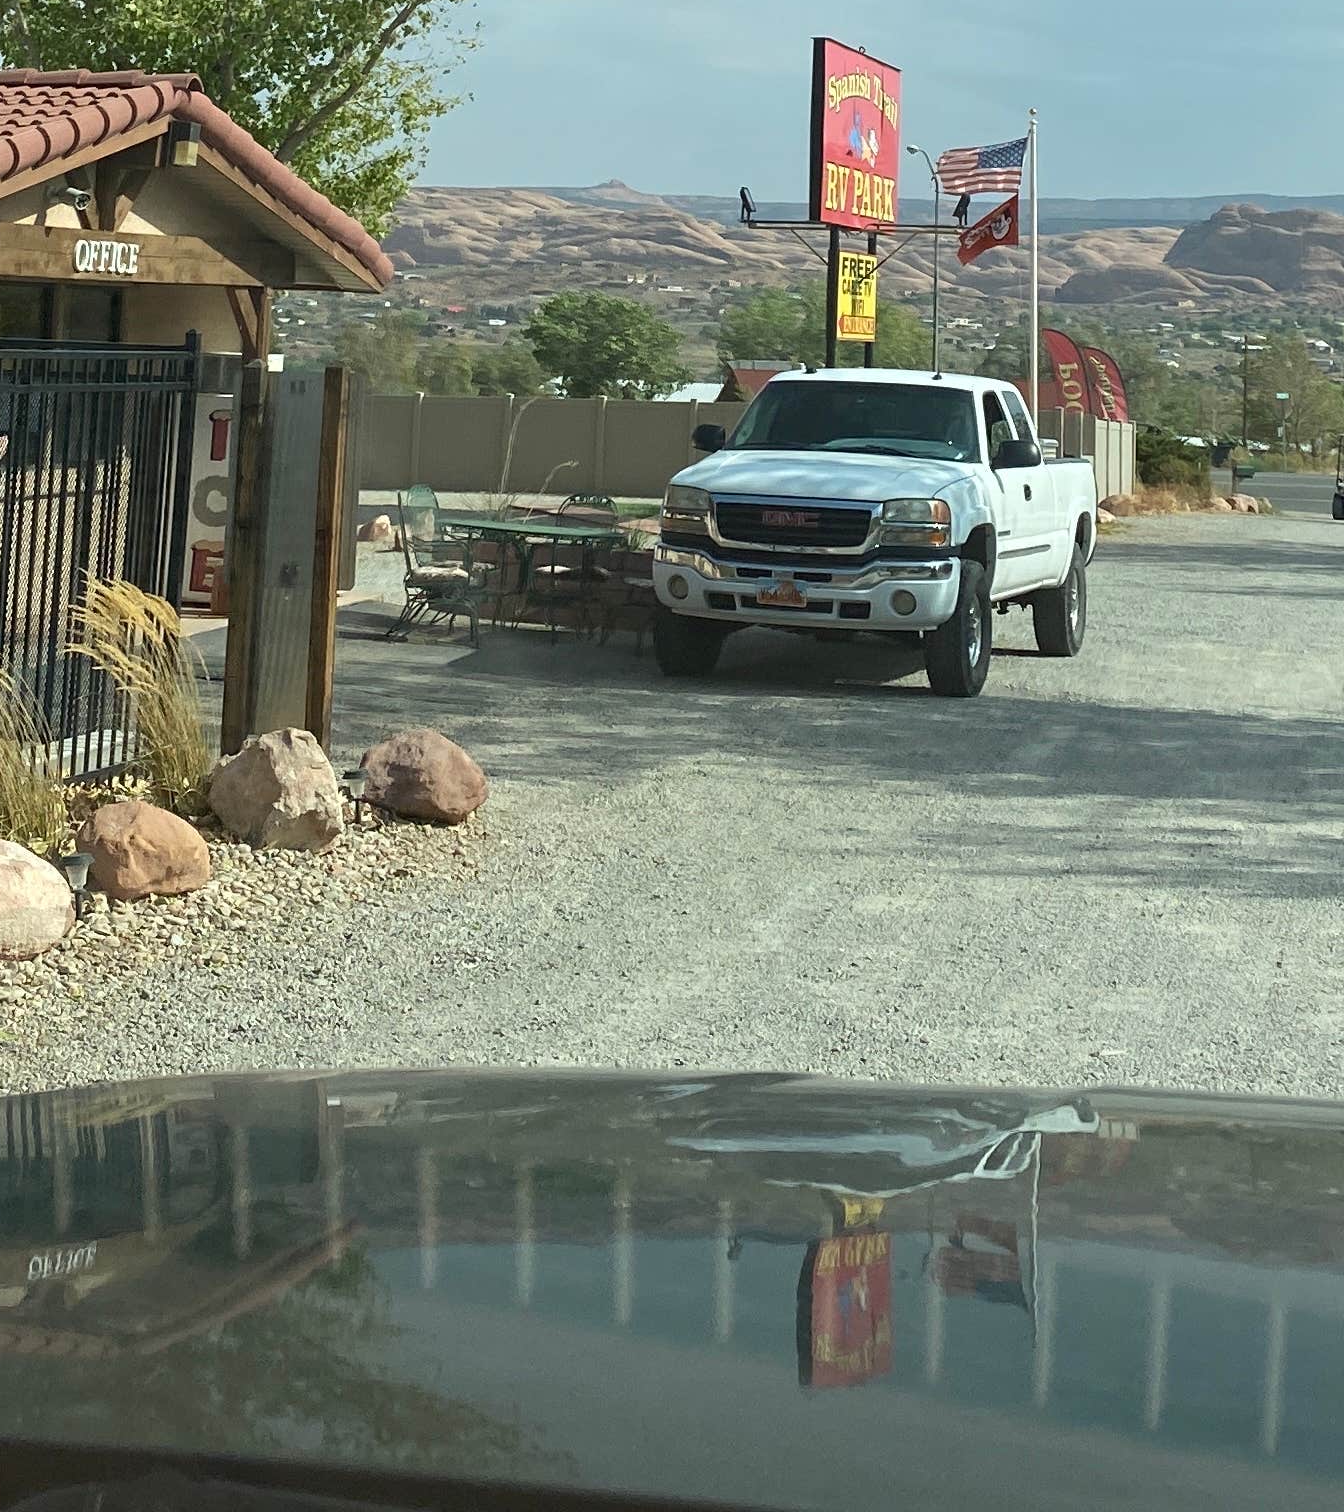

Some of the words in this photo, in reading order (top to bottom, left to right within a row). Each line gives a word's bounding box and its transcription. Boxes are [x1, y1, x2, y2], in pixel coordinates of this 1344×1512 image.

[828, 67, 871, 113] Spanish
[873, 74, 898, 130] Trail
[825, 162, 850, 212] RV
[851, 169, 895, 223] PARK
[74, 239, 141, 274] OFFICE
[842, 257, 874, 280] FREE!
[864, 281, 872, 297] TV
[761, 510, 822, 528] GMC
